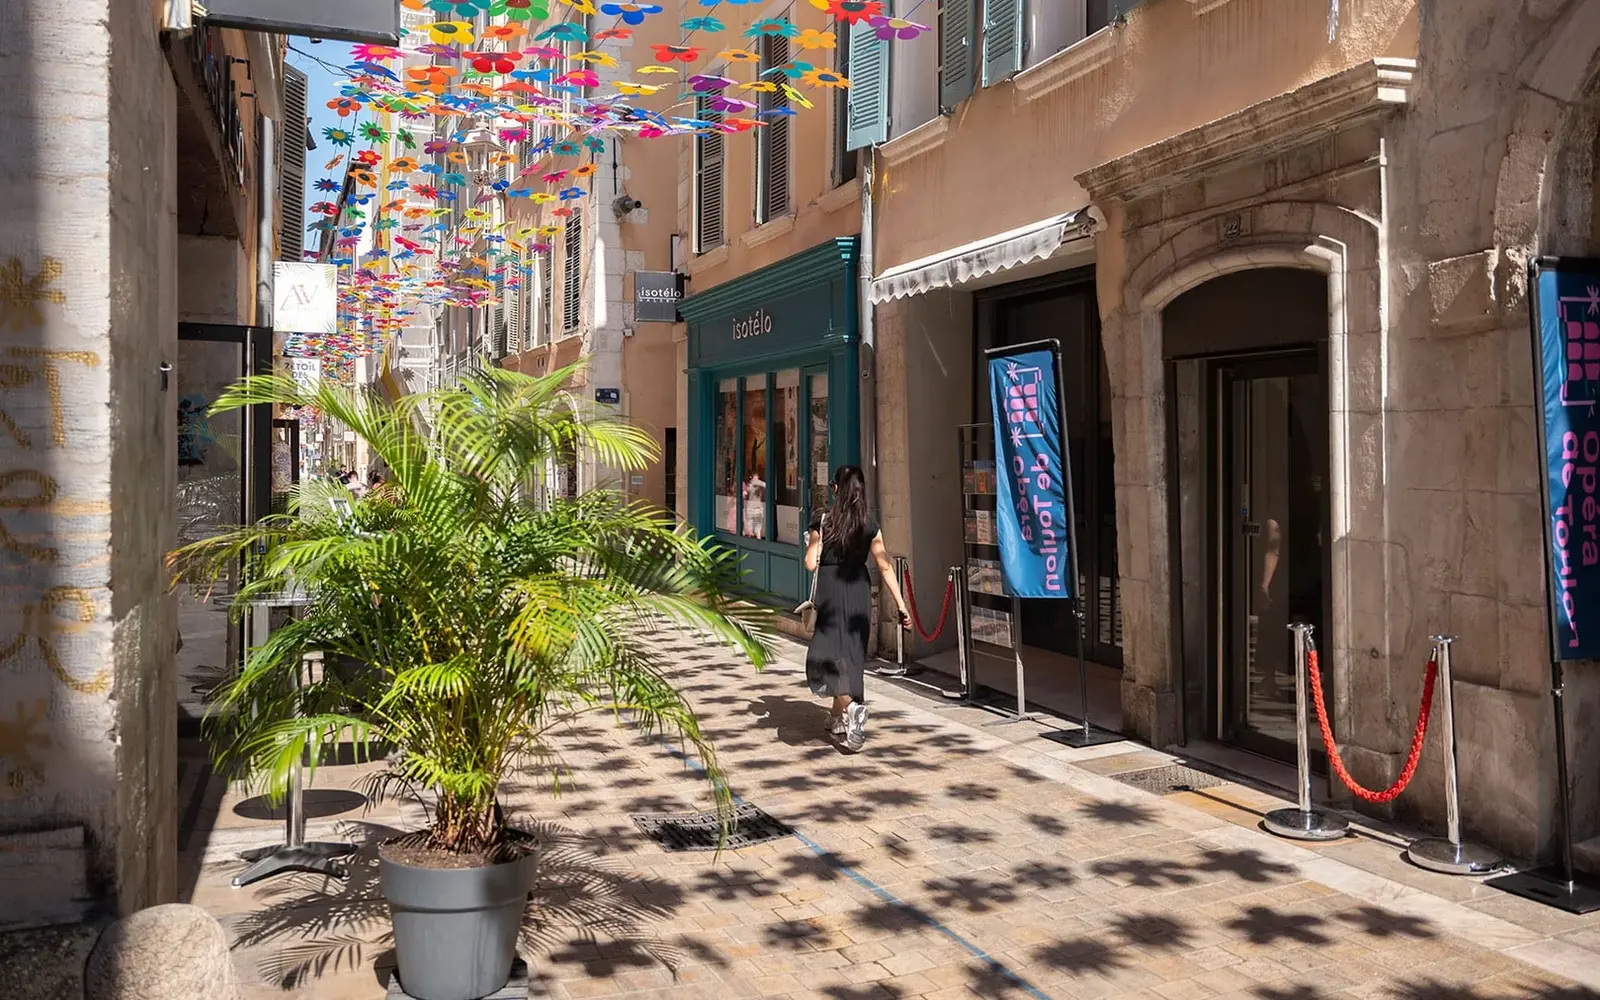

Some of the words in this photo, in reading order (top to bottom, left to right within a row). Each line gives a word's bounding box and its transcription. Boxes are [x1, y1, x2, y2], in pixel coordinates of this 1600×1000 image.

[641, 287, 681, 298] isotélo
[732, 308, 772, 340] isotélo
[1576, 431, 1600, 566] Opéra
